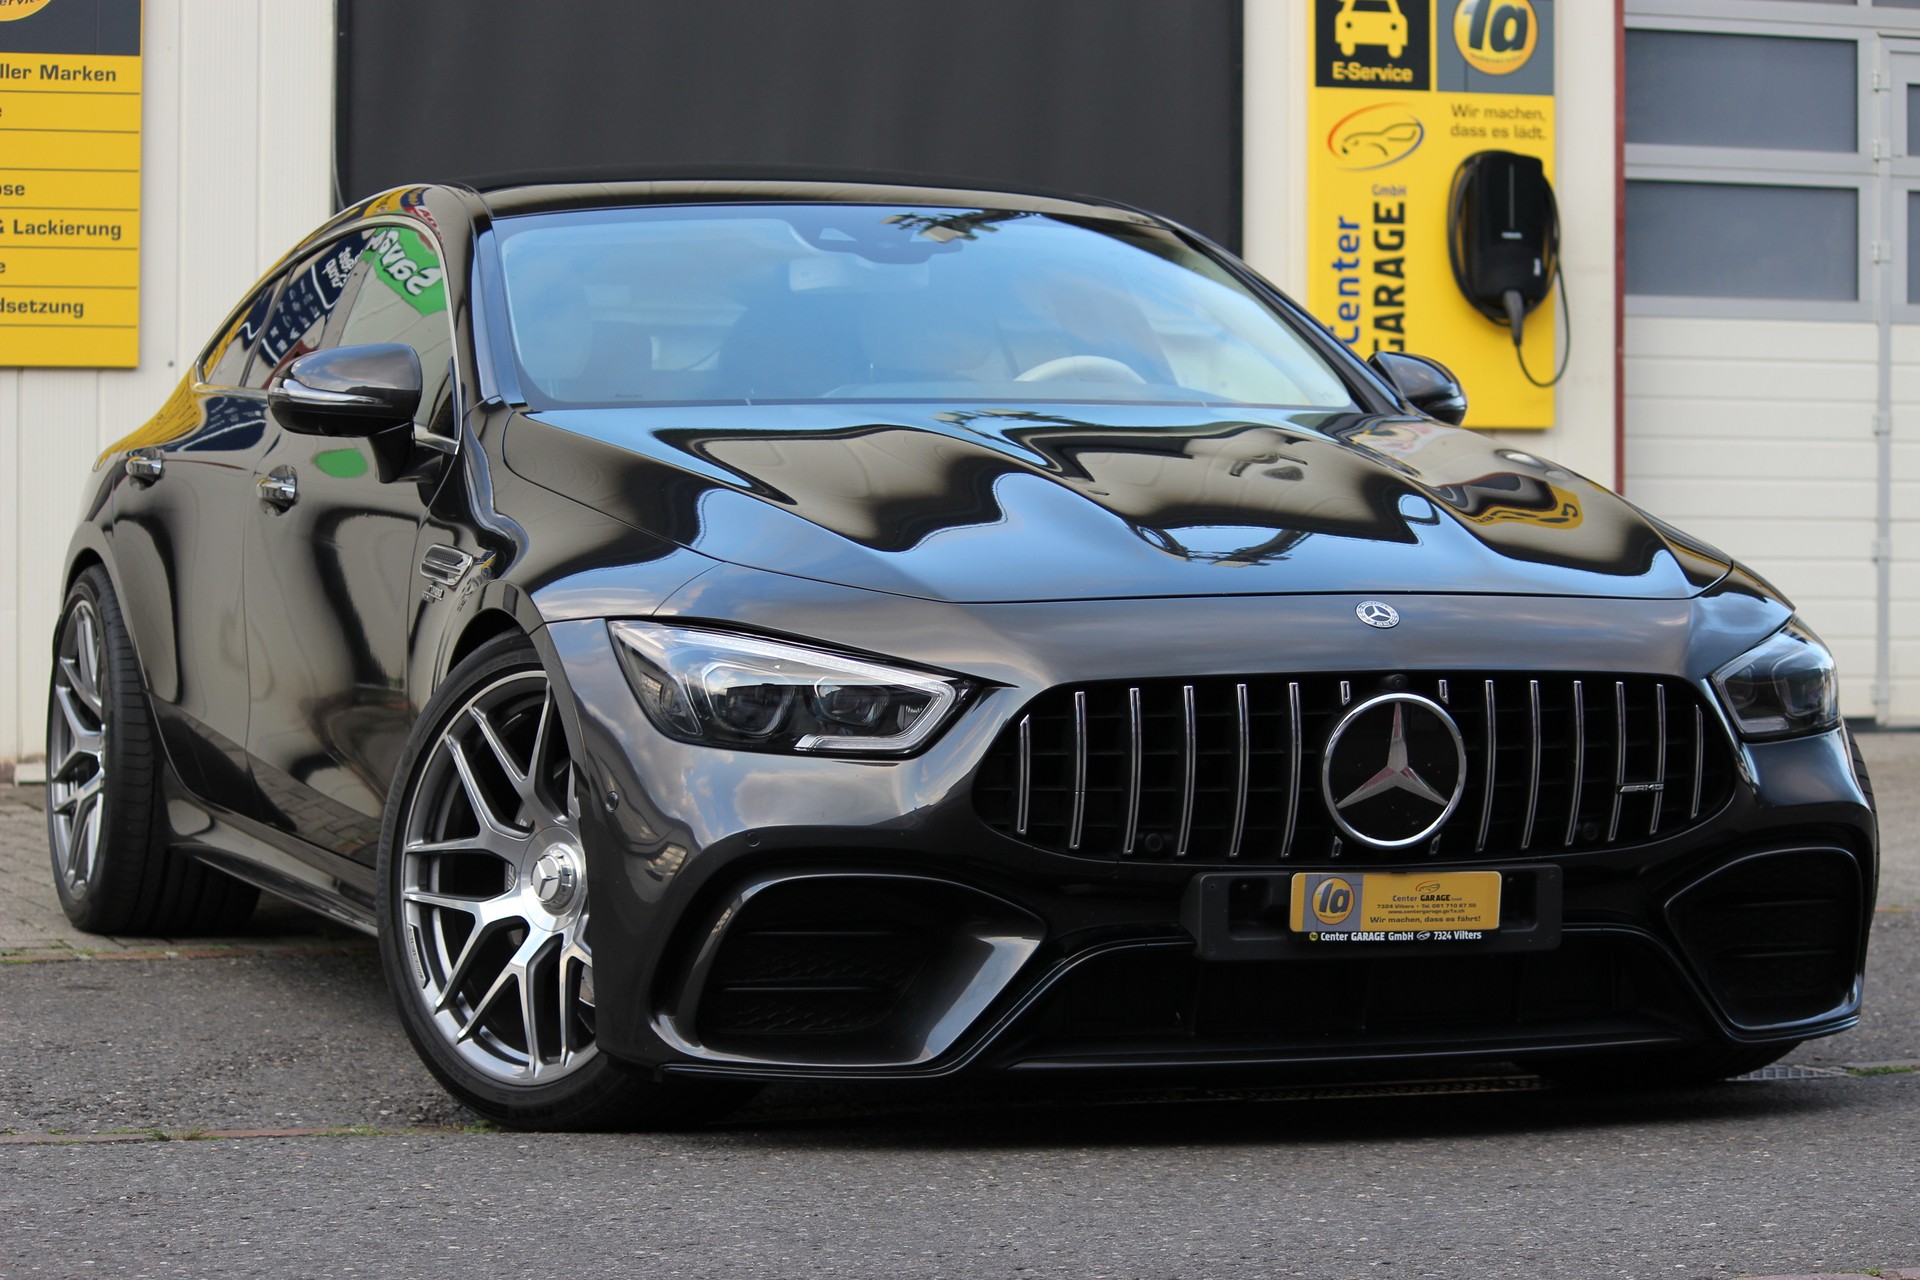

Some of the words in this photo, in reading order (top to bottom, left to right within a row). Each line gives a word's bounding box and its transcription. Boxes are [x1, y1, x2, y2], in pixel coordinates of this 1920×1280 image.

[1465, 0, 1528, 52] 1a
[40, 65, 116, 82] Marken
[1332, 61, 1413, 82] E-Service
[1451, 103, 1480, 119] Wir
[1484, 107, 1547, 122] machen,
[1451, 124, 1487, 138] dass
[1492, 126, 1509, 139] es
[13, 218, 122, 241] Lackierung
[1331, 215, 1361, 345] Center
[1373, 201, 1405, 353] GARAGE
[1319, 882, 1350, 914] 1a
[1392, 894, 1418, 902] Center
[1420, 894, 1451, 902] GARAGE
[1388, 916, 1422, 924] machen,
[1320, 932, 1348, 941] Center
[1350, 931, 1385, 941] GARAGE
[1388, 931, 1414, 941] GmbH
[1433, 931, 1452, 940] 7324
[1453, 930, 1482, 940] Vilters
